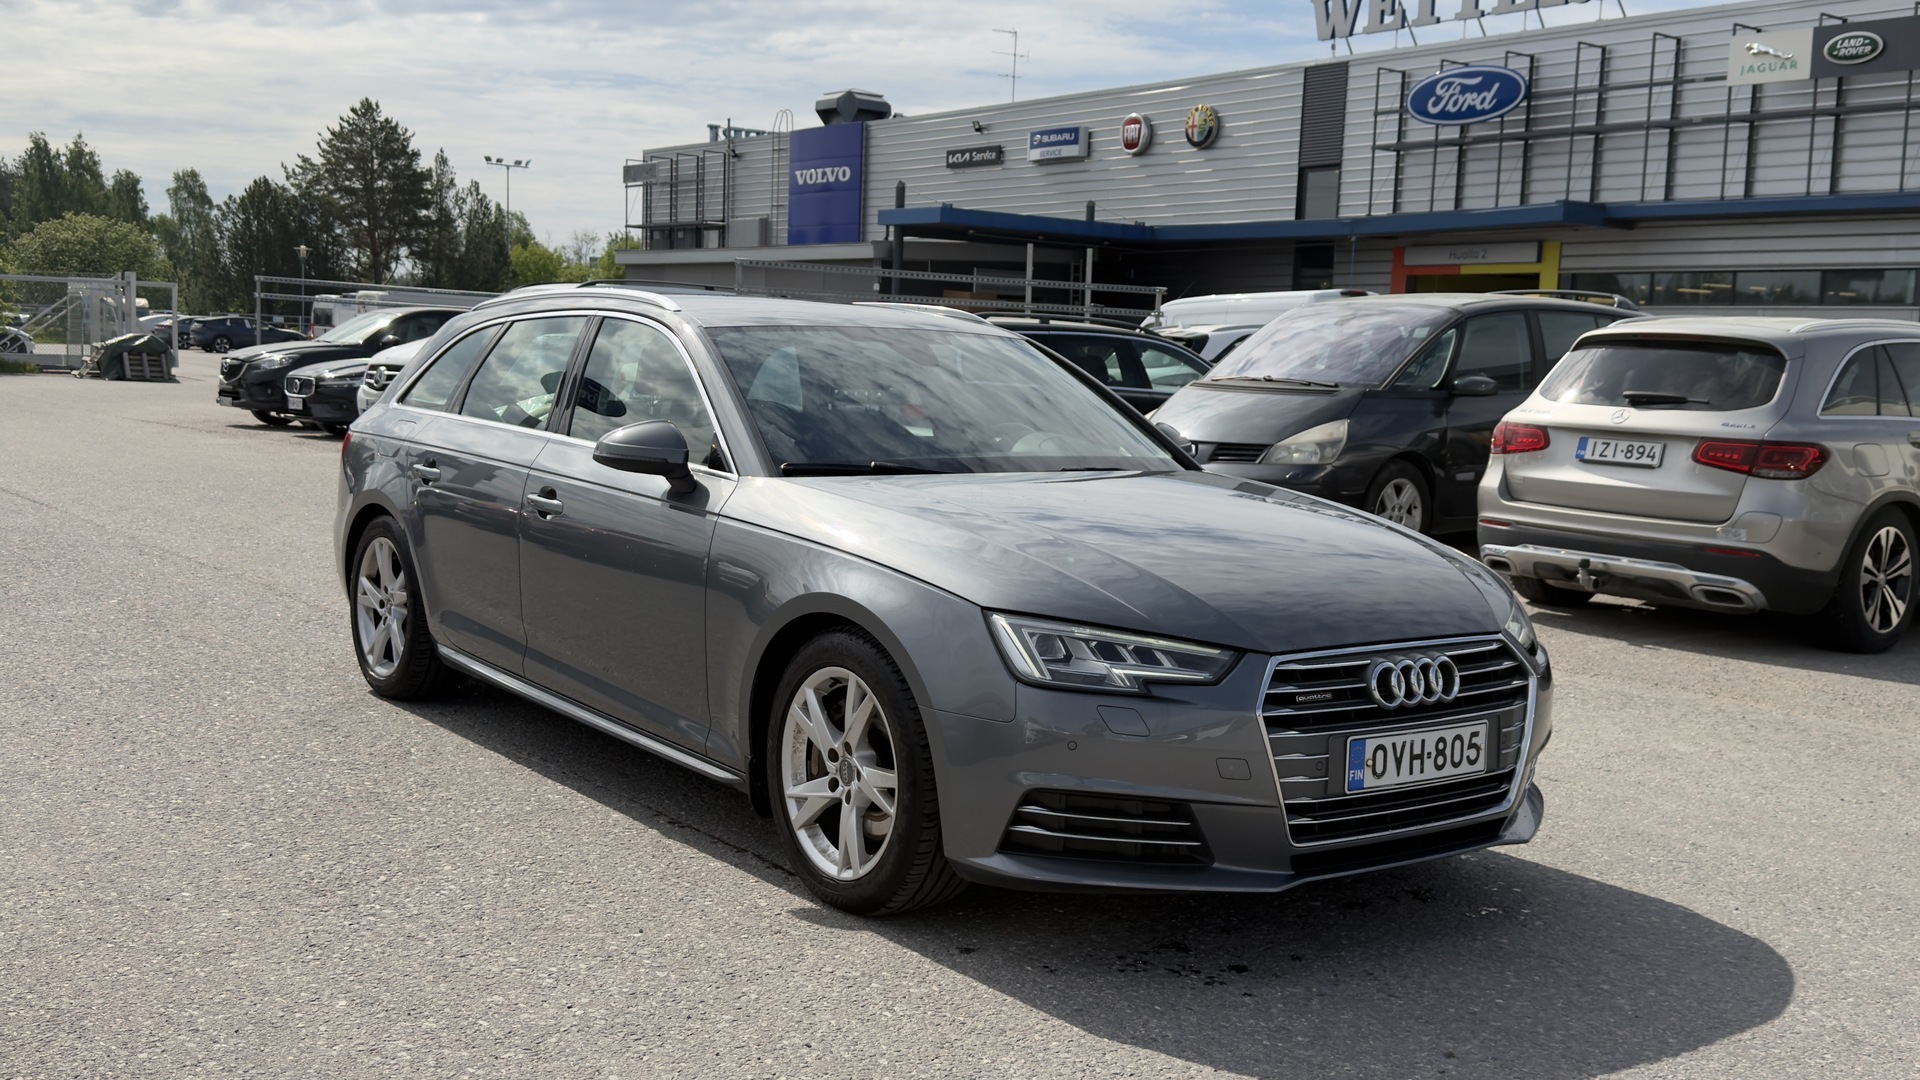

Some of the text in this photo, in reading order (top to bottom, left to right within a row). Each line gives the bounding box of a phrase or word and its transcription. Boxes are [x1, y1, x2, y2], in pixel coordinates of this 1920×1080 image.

[1740, 60, 1797, 76] JAGUAR
[1427, 76, 1500, 114] Ford
[1042, 133, 1074, 143] SUBARU
[1124, 124, 1141, 144] FIAT
[948, 151, 996, 163] KIA Service
[1040, 148, 1062, 157] SERVICE
[795, 166, 851, 185] VOLVO
[1481, 248, 1488, 259] 2
[1591, 440, 1657, 461] IZI-894
[1349, 731, 1480, 780] FIN OVH-805
